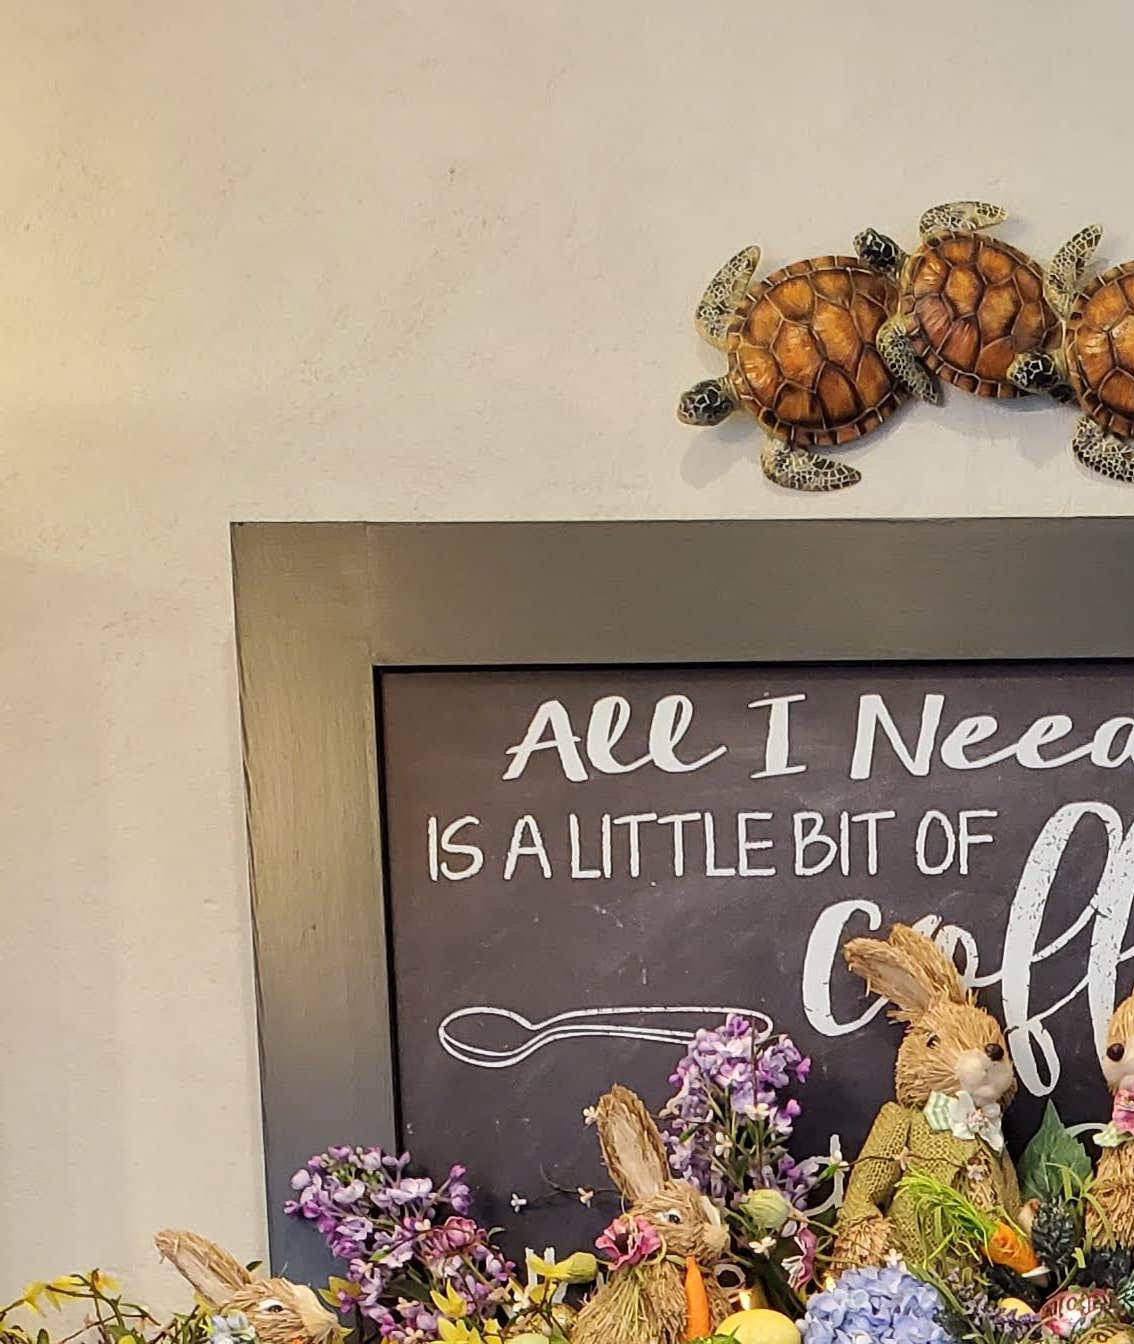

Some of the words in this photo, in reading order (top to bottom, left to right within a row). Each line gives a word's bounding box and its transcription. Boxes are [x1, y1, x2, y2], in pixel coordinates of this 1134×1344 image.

[502, 694, 728, 783] All
[747, 693, 807, 780] I
[427, 815, 484, 882] IS
[503, 814, 553, 881] A
[569, 811, 776, 880] LITTLE
[792, 809, 897, 878] BIT
[915, 808, 999, 876] OF
